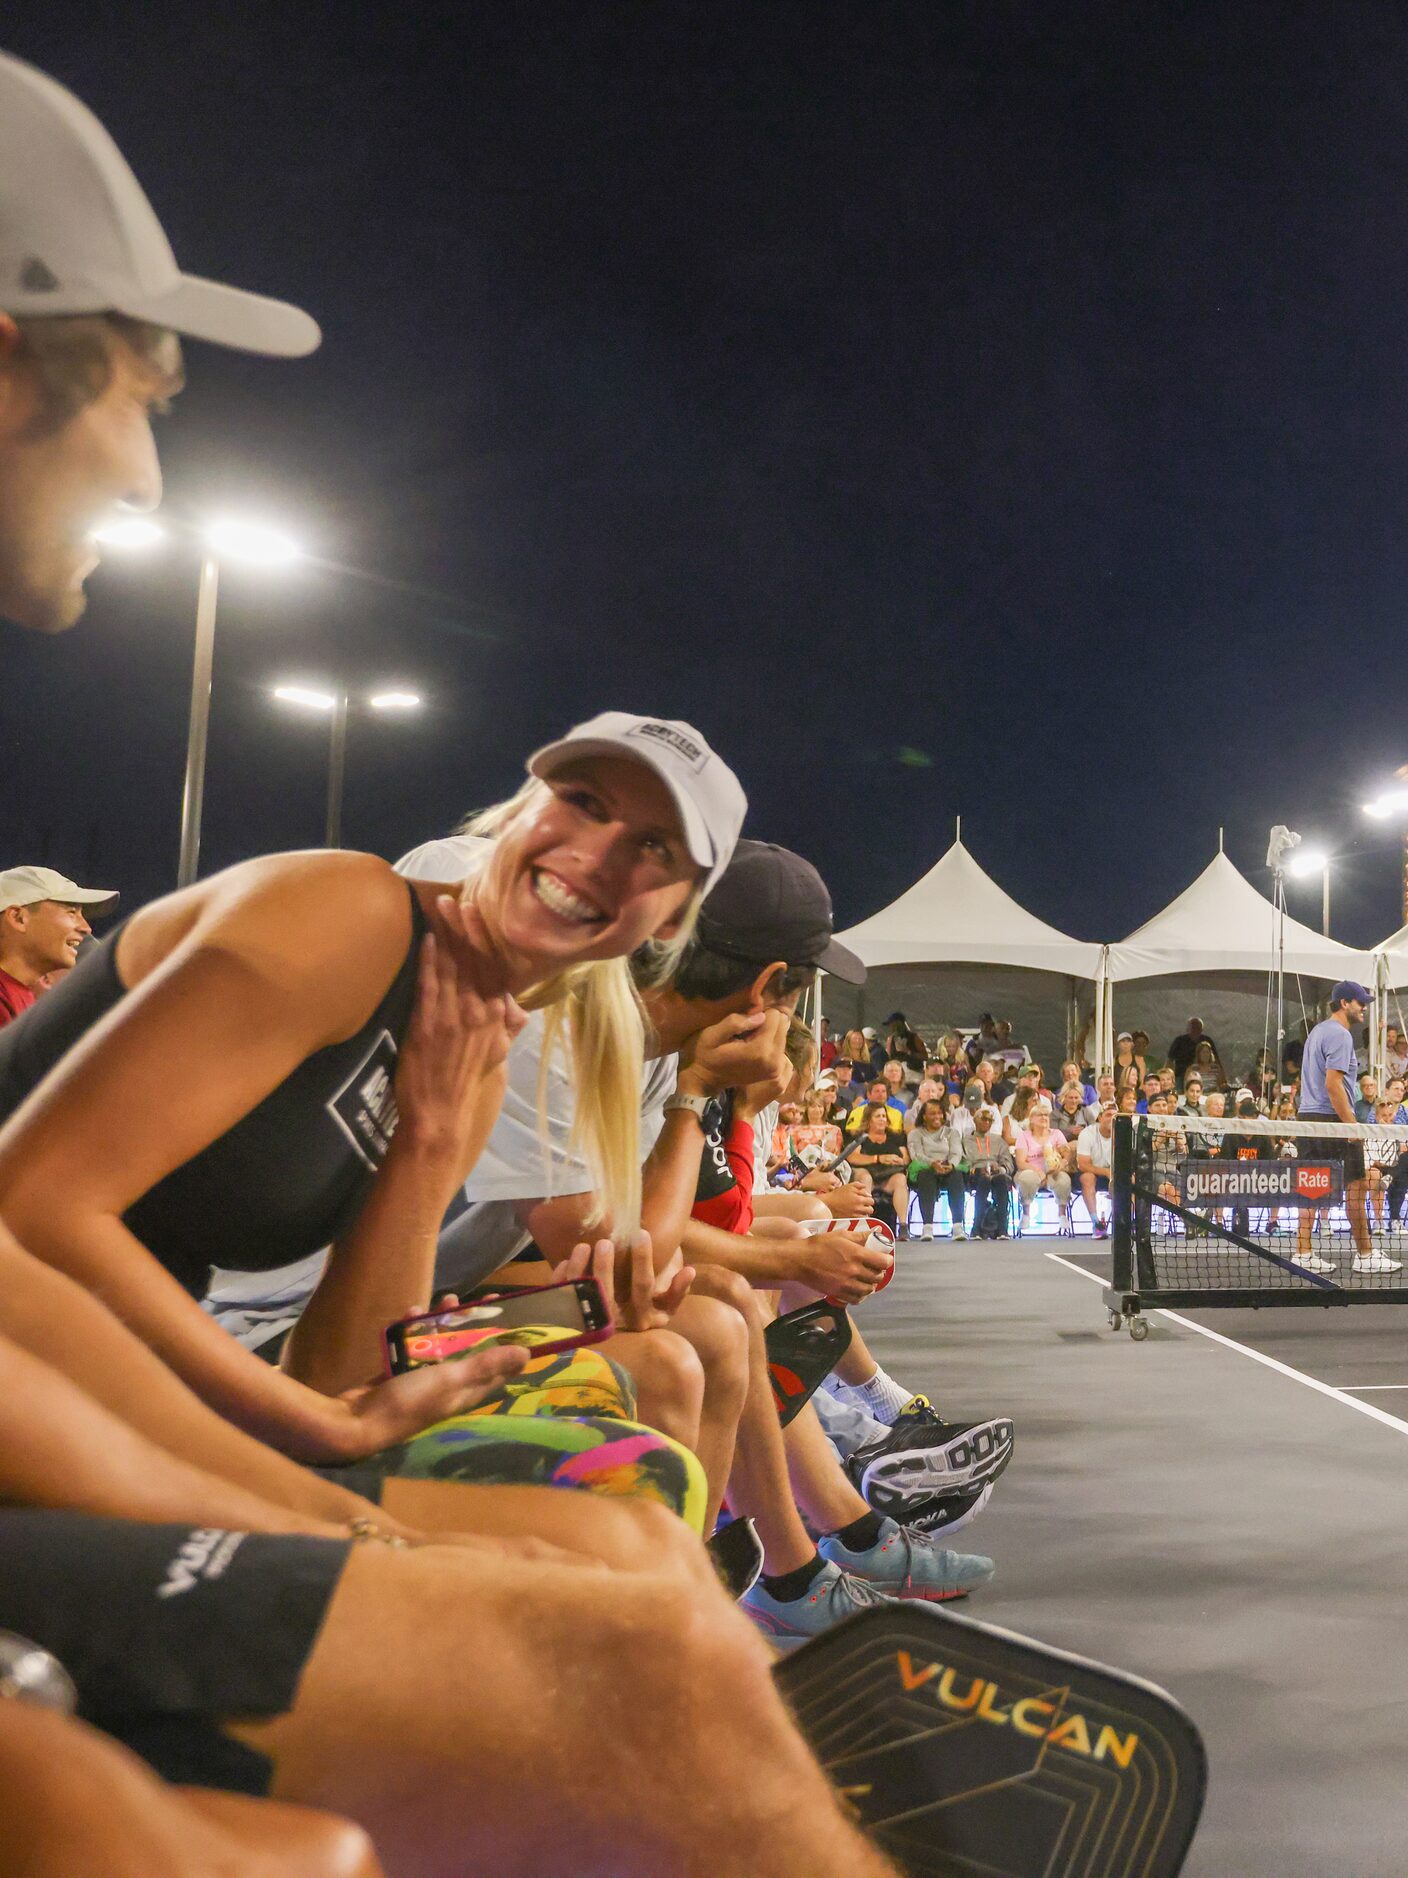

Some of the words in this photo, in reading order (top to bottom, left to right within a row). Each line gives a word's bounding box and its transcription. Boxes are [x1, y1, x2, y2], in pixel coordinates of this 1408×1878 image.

[1186, 1167, 1291, 1201] guaranteed
[1298, 1170, 1329, 1188] Rate
[896, 1650, 1140, 1769] VULCAN
